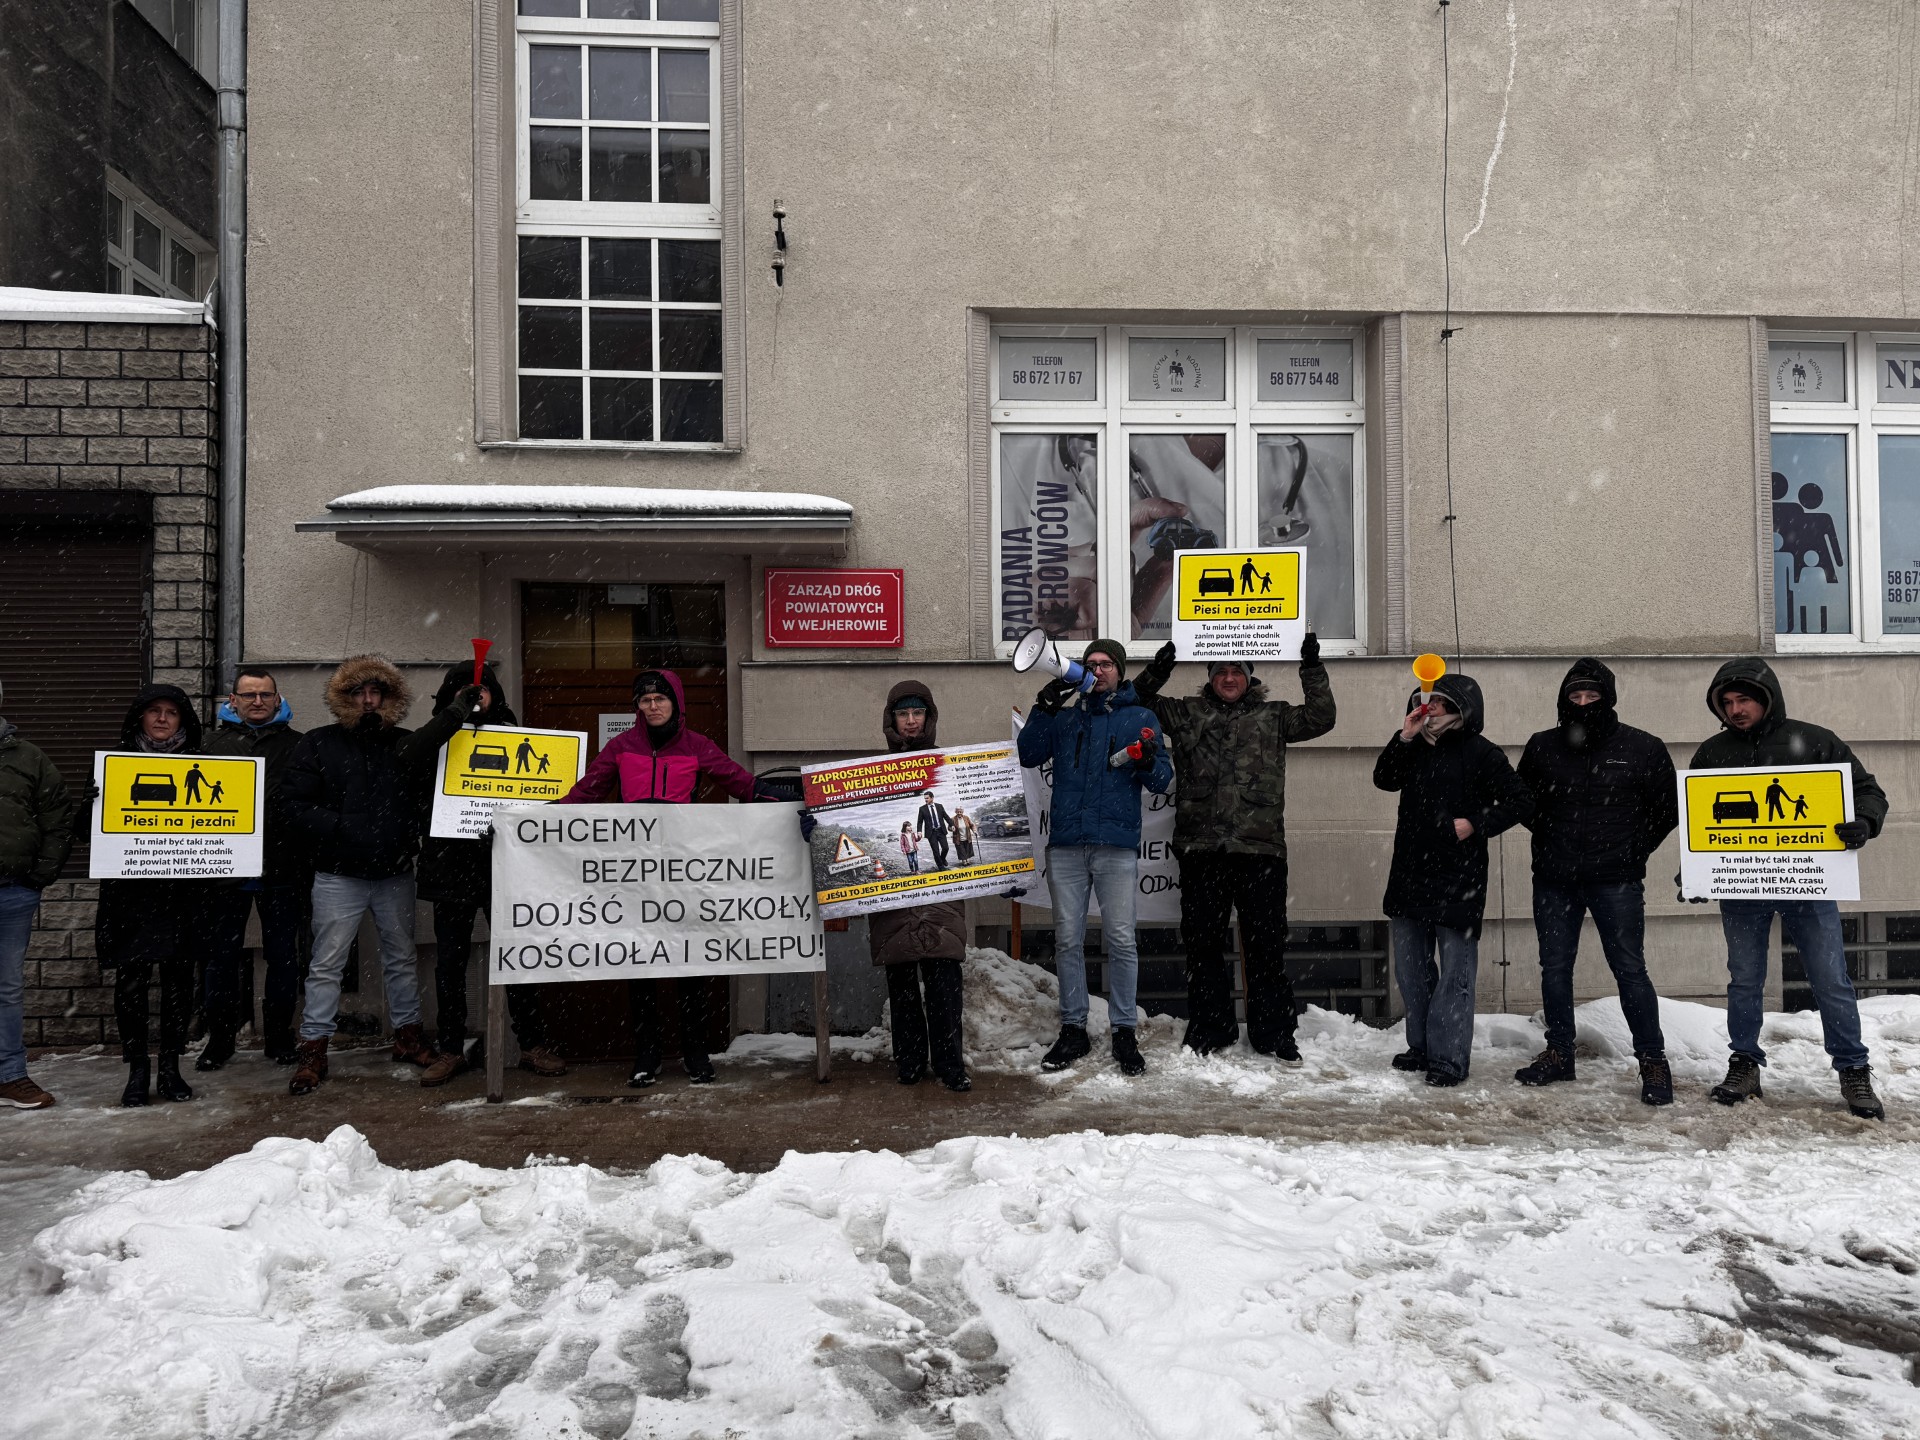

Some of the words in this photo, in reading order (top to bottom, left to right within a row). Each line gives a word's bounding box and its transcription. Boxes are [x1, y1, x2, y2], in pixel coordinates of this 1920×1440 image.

[1032, 356, 1062, 366] TELEFON
[1290, 357, 1320, 367] TELEFON
[1013, 371, 1028, 384] 58
[1029, 371, 1050, 384] 672
[1054, 371, 1066, 384] 17
[1068, 371, 1082, 384] 67
[1153, 355, 1168, 389] MEDYCYNA
[1270, 373, 1284, 386] 58
[1286, 373, 1307, 385] 677
[1310, 372, 1323, 385] 54
[1326, 372, 1339, 385] 48
[1031, 481, 1068, 641] IEROWCÓW
[1001, 527, 1032, 641] BADANIA
[1888, 571, 1902, 585] 58
[1905, 571, 1920, 585] 67
[788, 585, 841, 598] ZARZĄD
[845, 582, 881, 596] DRÓG
[1888, 588, 1902, 602] 58
[1905, 588, 1920, 602] 67
[786, 602, 883, 613] POWIATOWYCH
[1194, 605, 1220, 614] Piesi
[1225, 606, 1240, 614] na
[1246, 604, 1282, 616] jezdni
[782, 620, 795, 630] W
[798, 620, 887, 630] WEJHEROWIE
[1232, 648, 1281, 656] MIESZKAŃCY
[958, 753, 985, 761] programie
[811, 765, 882, 784] ZAPROSZENIE
[884, 763, 898, 772] NA
[900, 757, 936, 770] SPACER
[462, 780, 492, 791] Piesi
[496, 784, 513, 792] na
[520, 784, 559, 795] jezdni
[822, 785, 841, 794] UL.
[843, 769, 928, 791] WEJHEROWSKĄ
[845, 787, 888, 799] PĘTKOWICE
[894, 781, 922, 790] GOWINO
[124, 815, 158, 826] Piesi
[164, 818, 184, 826] na
[191, 816, 236, 829] jezdni
[474, 818, 493, 826] powi
[517, 818, 658, 843] CHCEMY
[134, 838, 146, 846] Tu
[148, 838, 166, 846] miał
[168, 838, 184, 848] być
[186, 838, 202, 846] taki
[1709, 833, 1742, 844] Piesi
[1748, 836, 1768, 844] na
[1776, 832, 1824, 846] jezdni
[124, 848, 150, 856] zanim
[152, 848, 197, 857] powstanie
[124, 858, 138, 866] ale
[140, 858, 170, 867] powiat
[1720, 856, 1731, 864] Tu
[1734, 856, 1753, 864] miał
[1755, 856, 1770, 865] być
[121, 868, 171, 876] ufundowali
[173, 866, 234, 876] MIESZKAŃCY
[582, 857, 774, 883] BEZPIECZNIE
[1739, 867, 1786, 875] powstanie
[826, 891, 847, 900] JEŚLI
[861, 886, 879, 894] JEST
[881, 878, 927, 890] BEZPIECZNE
[938, 871, 972, 882] PROSIMY
[974, 866, 998, 876] PRZEJŚĆ
[1011, 862, 1029, 870] TĘDY
[1728, 877, 1759, 885] powiat
[1762, 886, 1827, 894] MIESZKAŃCY
[512, 894, 624, 928] DOJŚĆ
[641, 900, 686, 923] DO
[700, 894, 812, 922] SZKOŁY,
[498, 938, 670, 970] KOŚCIOŁA
[684, 940, 689, 962] I
[704, 934, 824, 962] SKLEPU!
